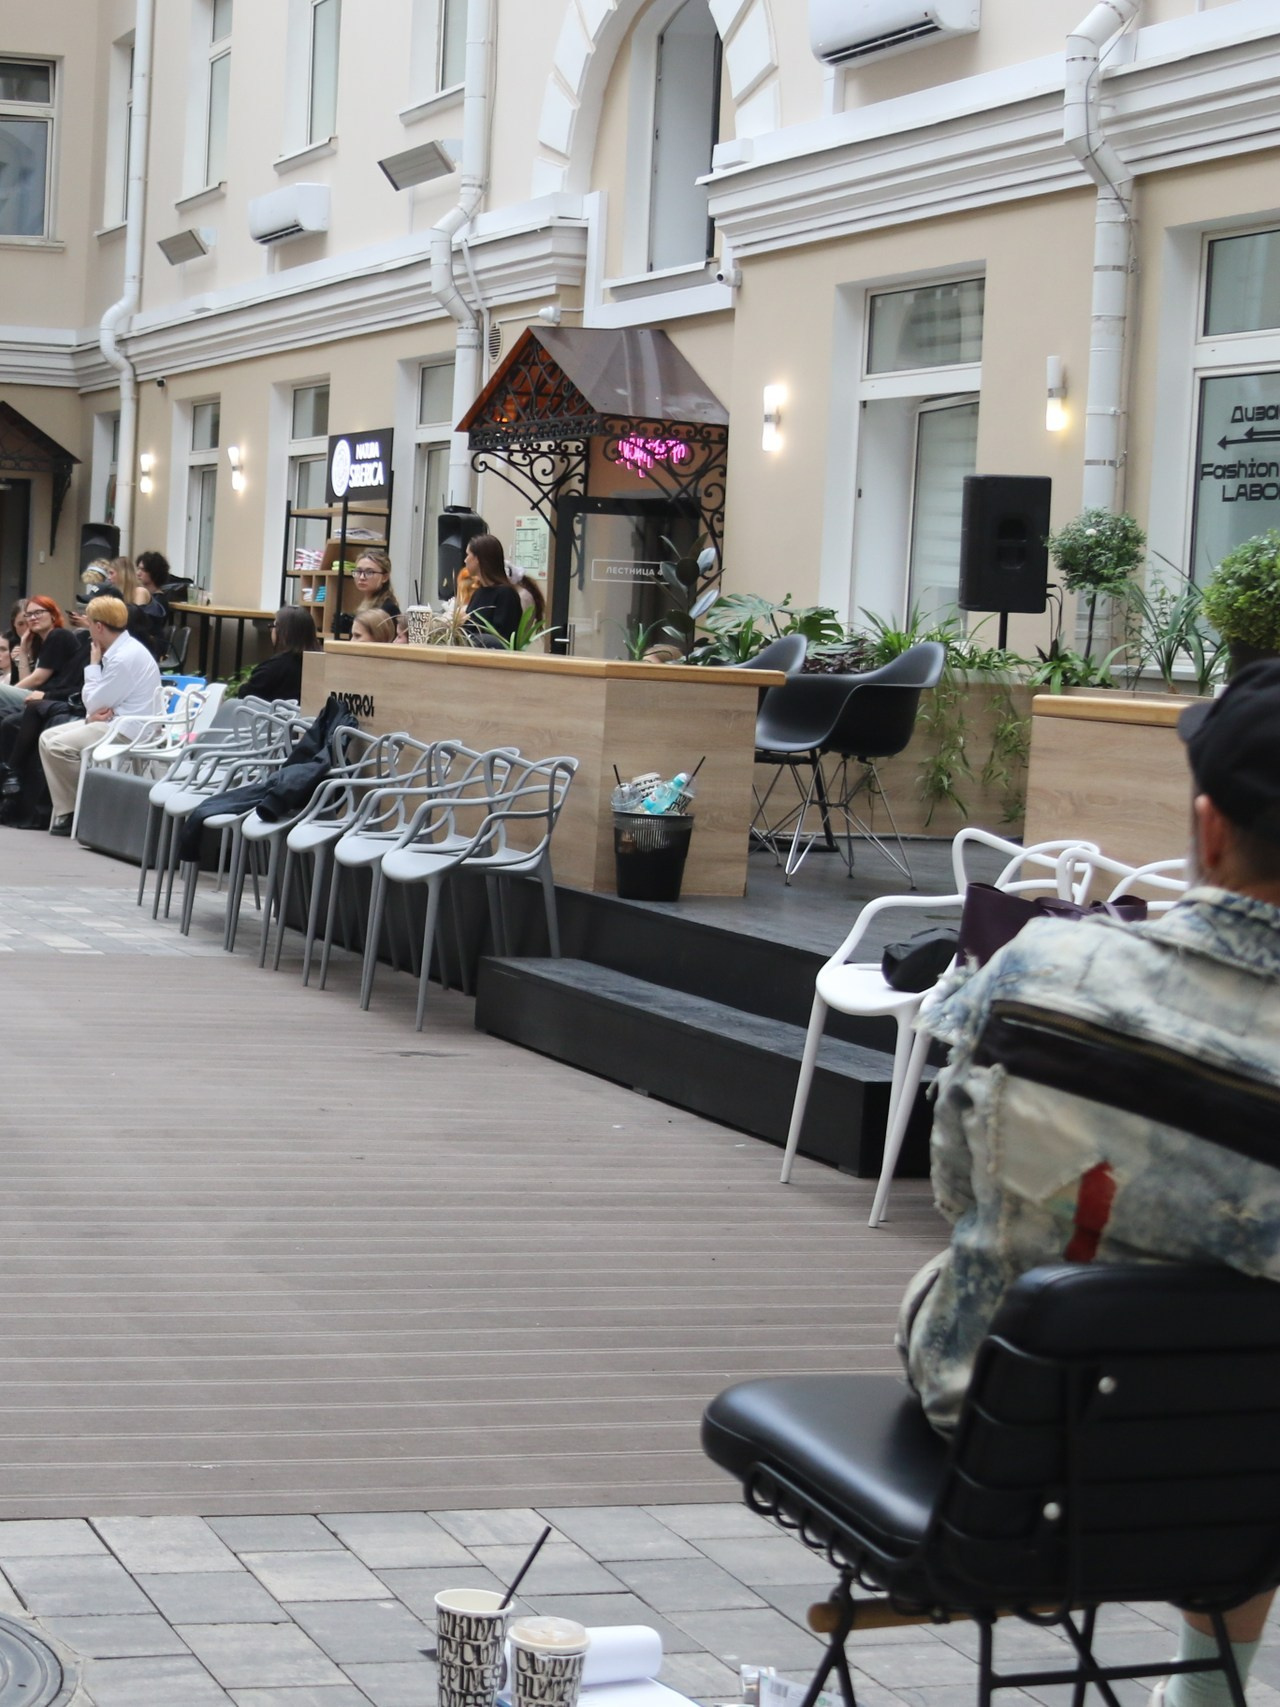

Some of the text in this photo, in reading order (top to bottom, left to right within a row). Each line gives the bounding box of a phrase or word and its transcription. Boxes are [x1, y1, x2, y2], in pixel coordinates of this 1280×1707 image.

[348, 461, 384, 488] SIBERICA
[1200, 457, 1279, 481] Fashion
[1222, 482, 1280, 502] LABO
[606, 566, 655, 577] ЛЕСТНИЦА
